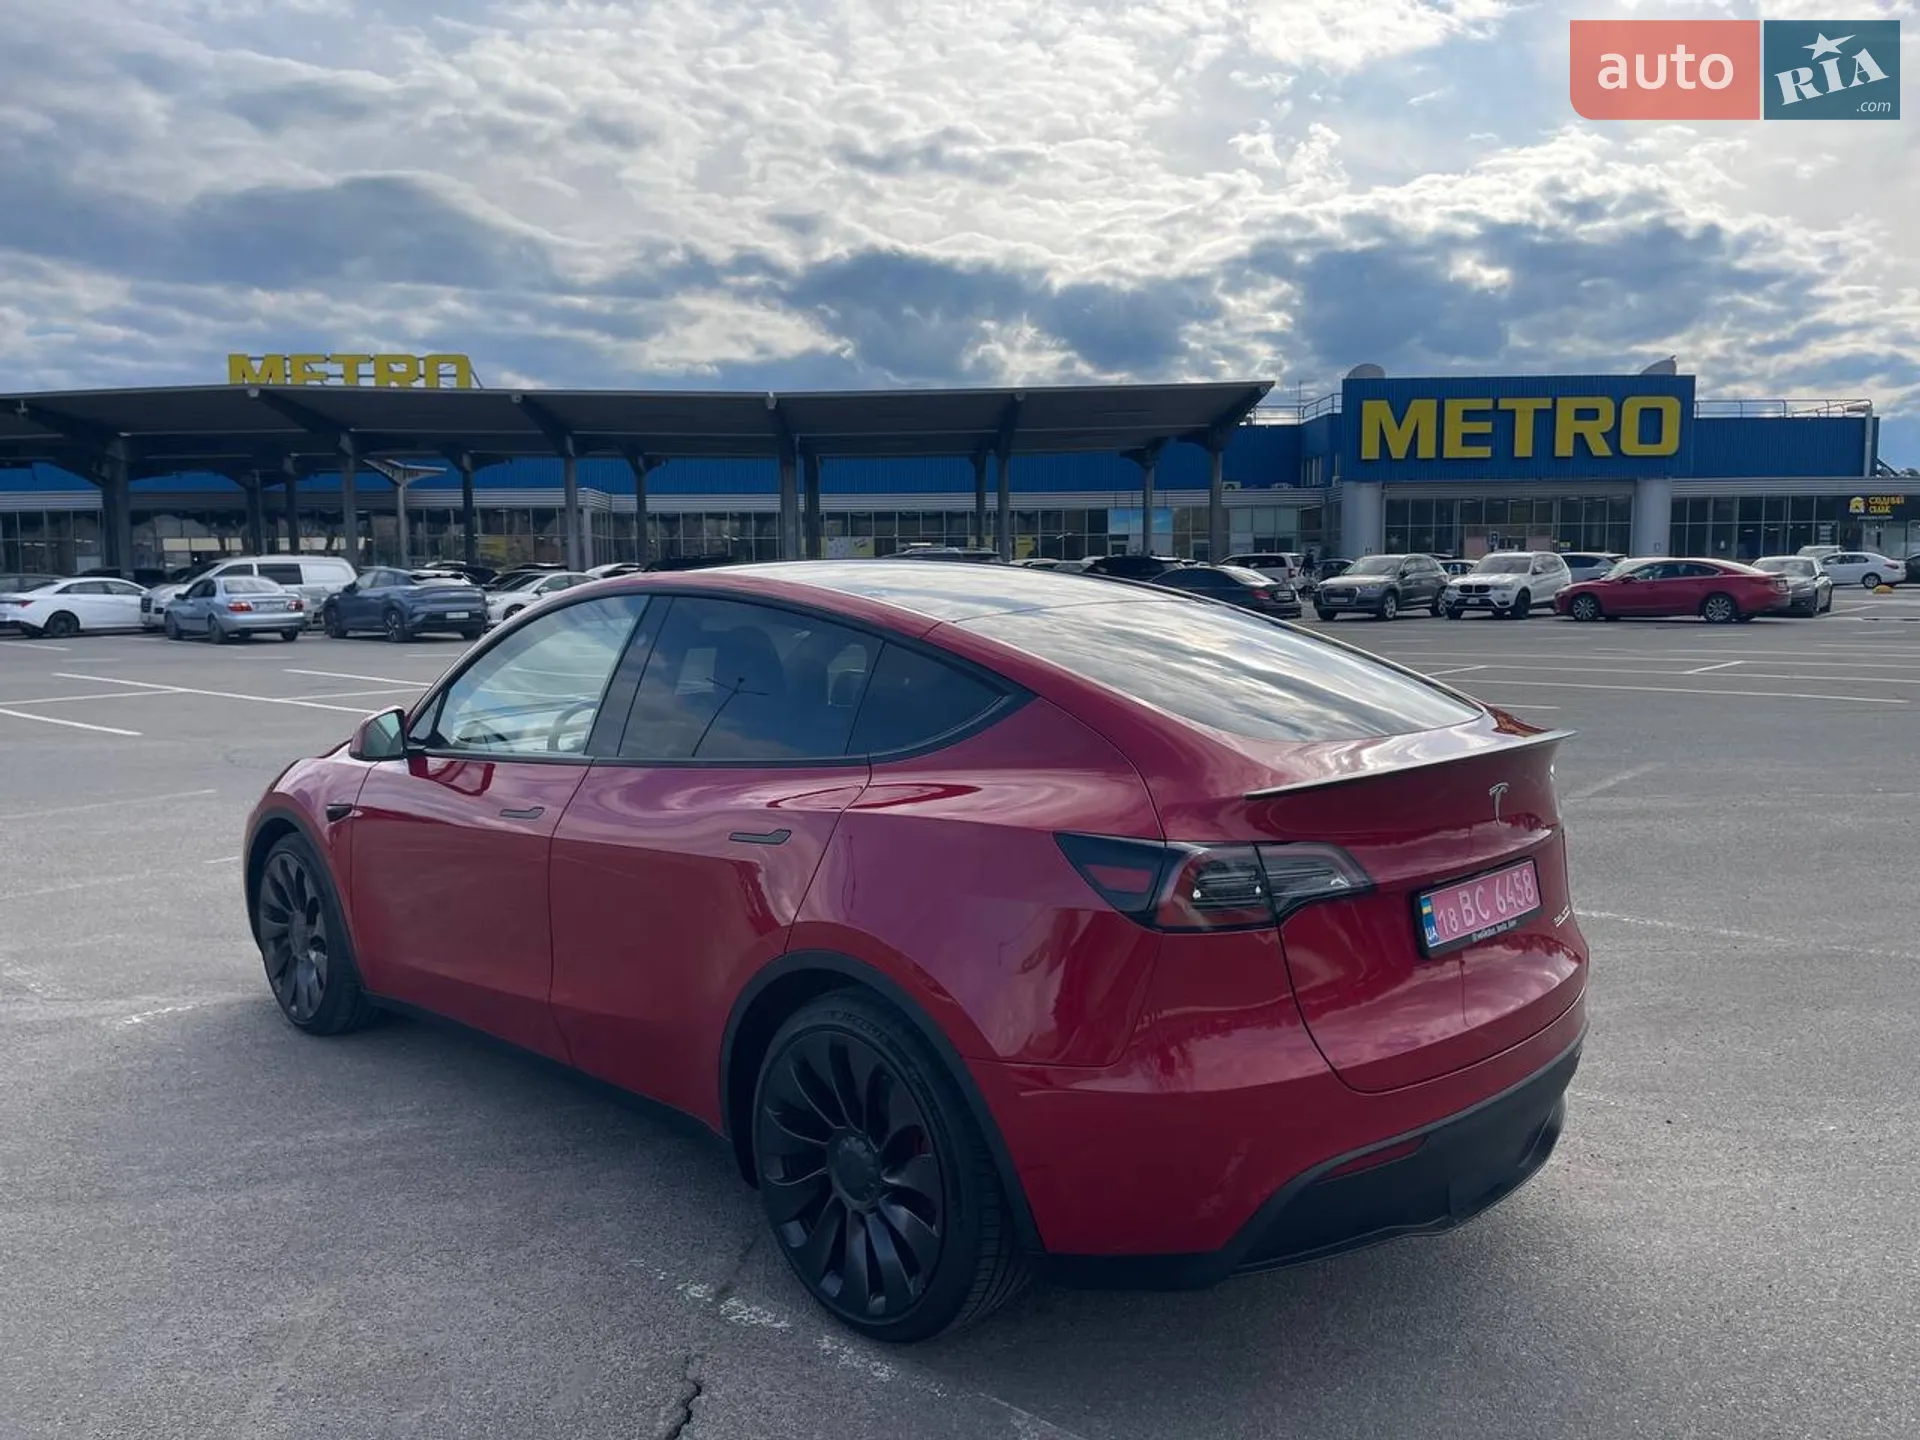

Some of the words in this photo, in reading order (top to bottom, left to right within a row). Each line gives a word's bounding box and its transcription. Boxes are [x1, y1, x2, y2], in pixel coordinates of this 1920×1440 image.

[228, 353, 471, 388] METRO
[1361, 396, 1681, 460] METRO
[1438, 907, 1460, 935] 18
[1458, 885, 1491, 927] BC
[1495, 868, 1535, 915] 6458
